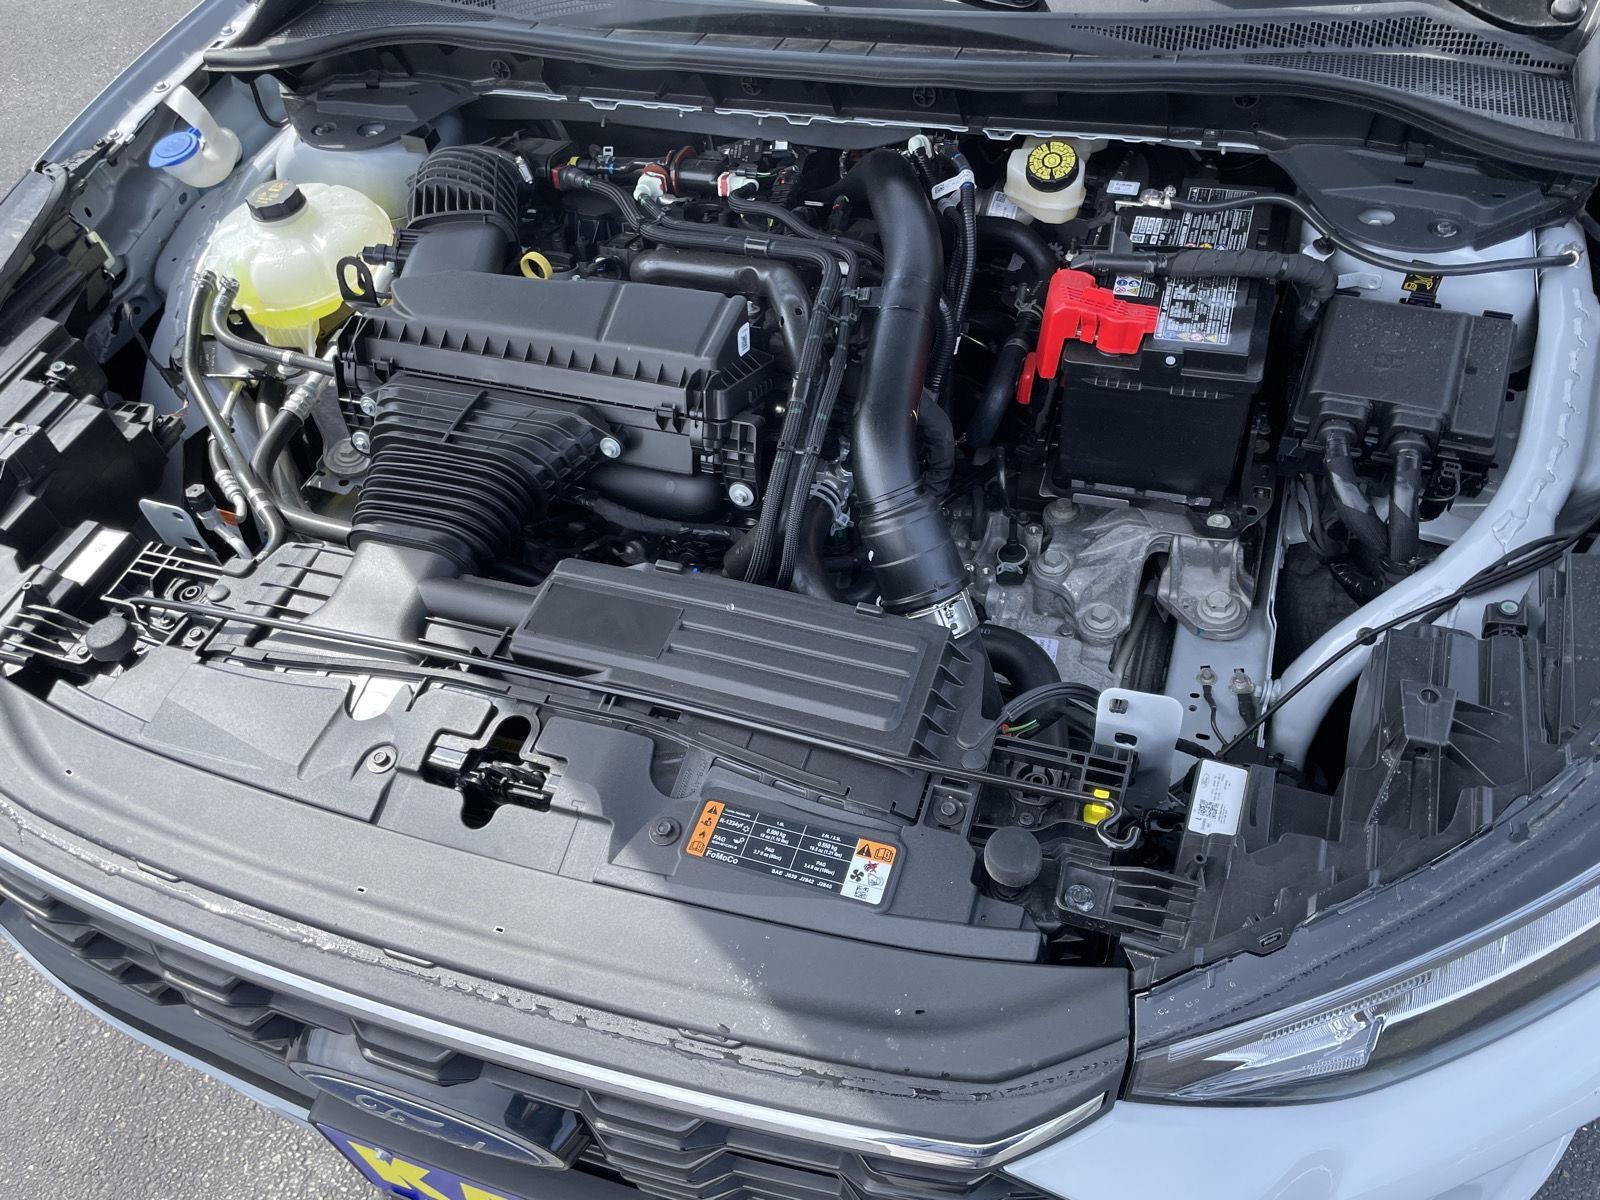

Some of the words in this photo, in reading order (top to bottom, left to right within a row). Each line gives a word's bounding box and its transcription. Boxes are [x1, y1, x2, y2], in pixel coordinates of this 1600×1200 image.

[719, 817, 744, 829] R-1234yf
[713, 834, 727, 843] PAG
[705, 849, 739, 865] FoMoCo
[815, 860, 827, 868] PAG
[771, 868, 784, 876] SAE
